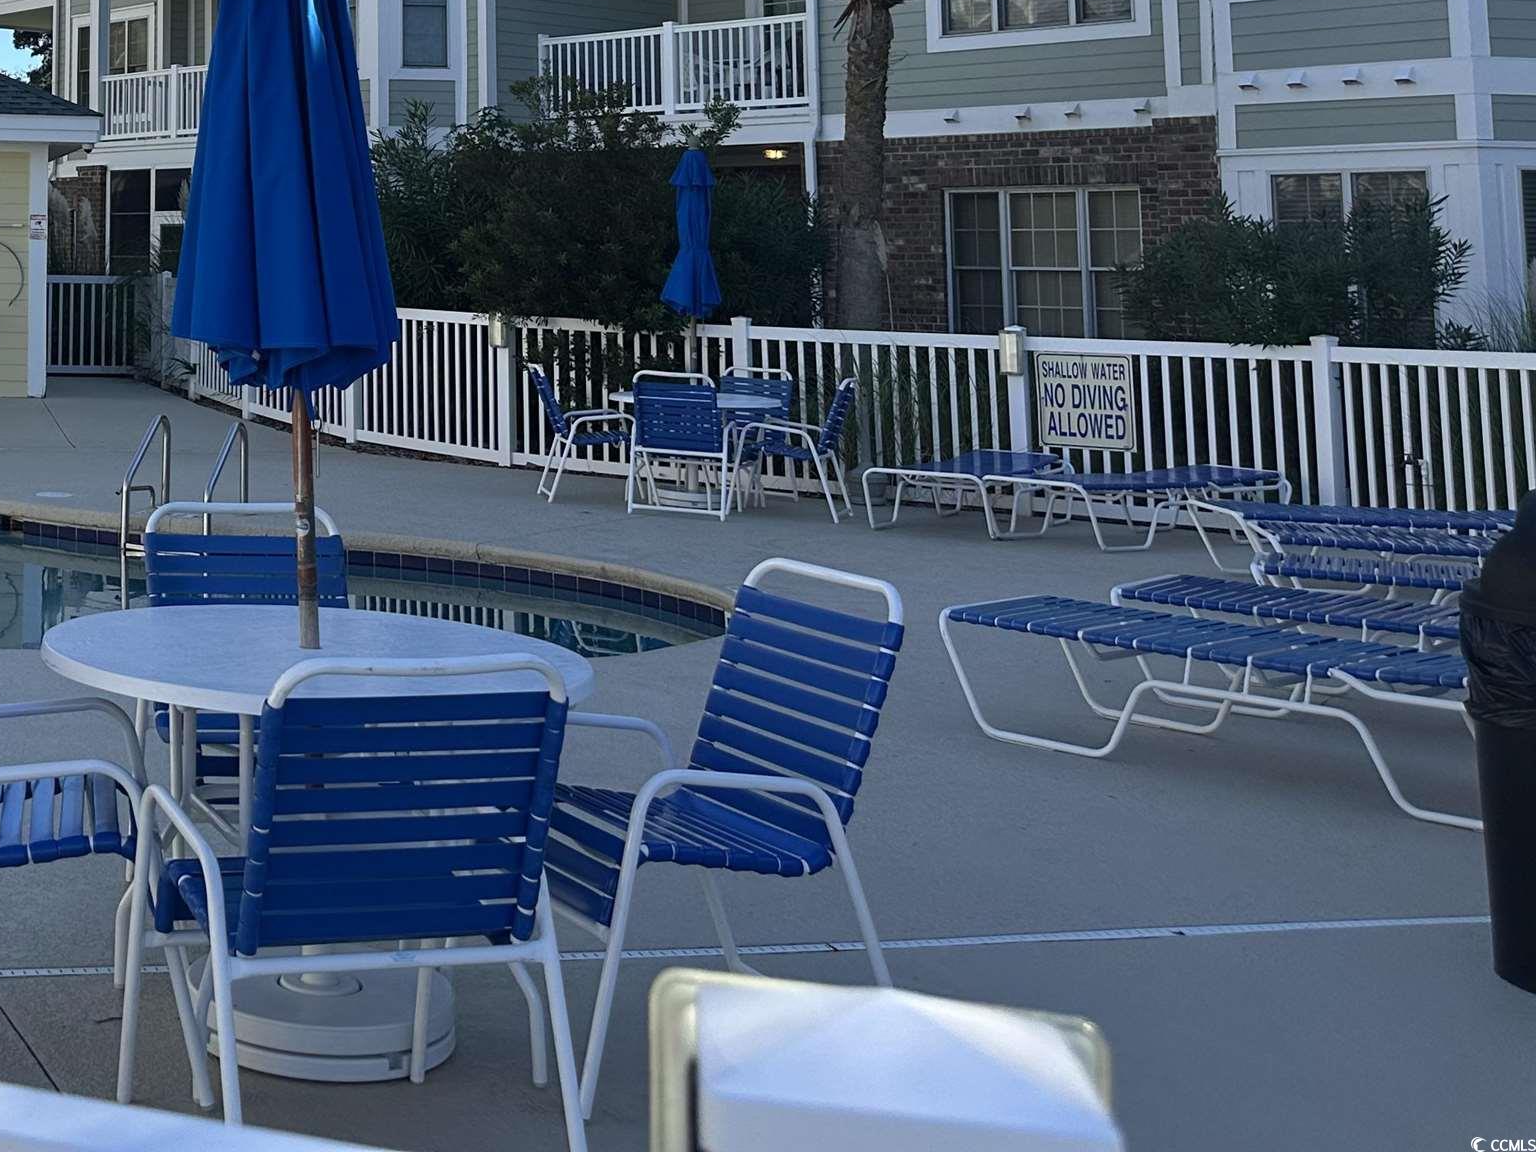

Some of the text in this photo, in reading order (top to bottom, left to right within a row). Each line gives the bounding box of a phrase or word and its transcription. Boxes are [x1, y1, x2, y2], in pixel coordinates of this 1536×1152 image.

[1042, 361, 1126, 381] SHALLOW WATER
[1044, 383, 1127, 411] NO DIVING
[1047, 411, 1126, 440] ALLOWED
